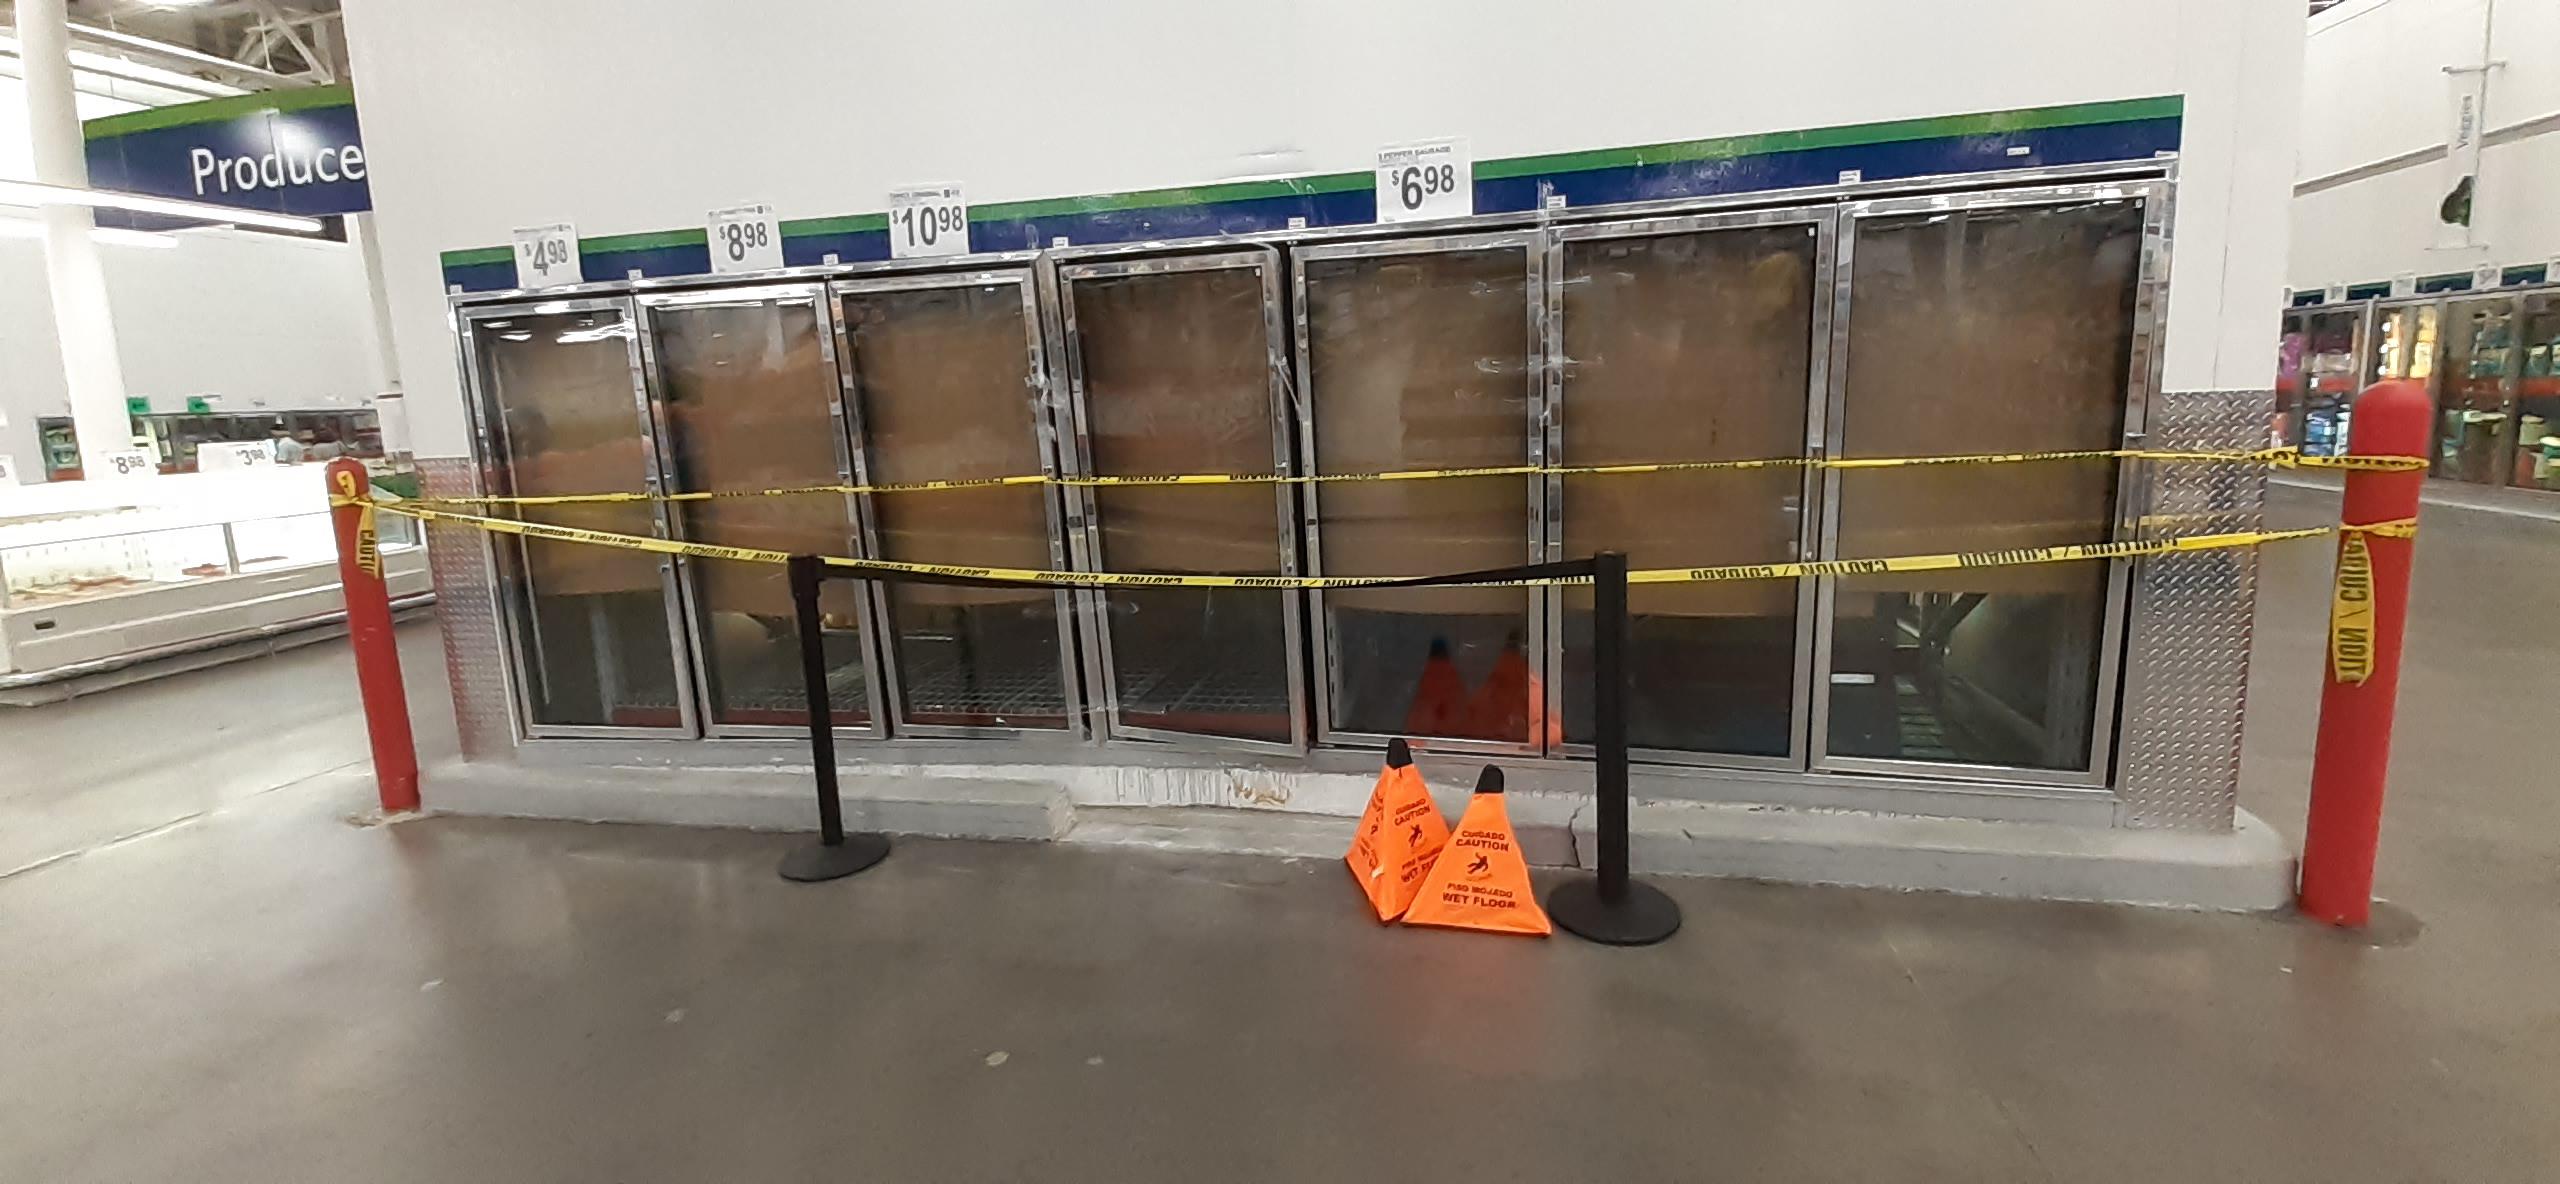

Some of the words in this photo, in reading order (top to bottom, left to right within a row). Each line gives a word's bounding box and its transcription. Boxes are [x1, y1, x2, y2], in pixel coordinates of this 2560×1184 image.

[191, 145, 365, 195] Produce
[1456, 838, 1510, 852] CAUTION
[1443, 892, 1470, 904] WET
[1473, 896, 1517, 909] FLOOR
